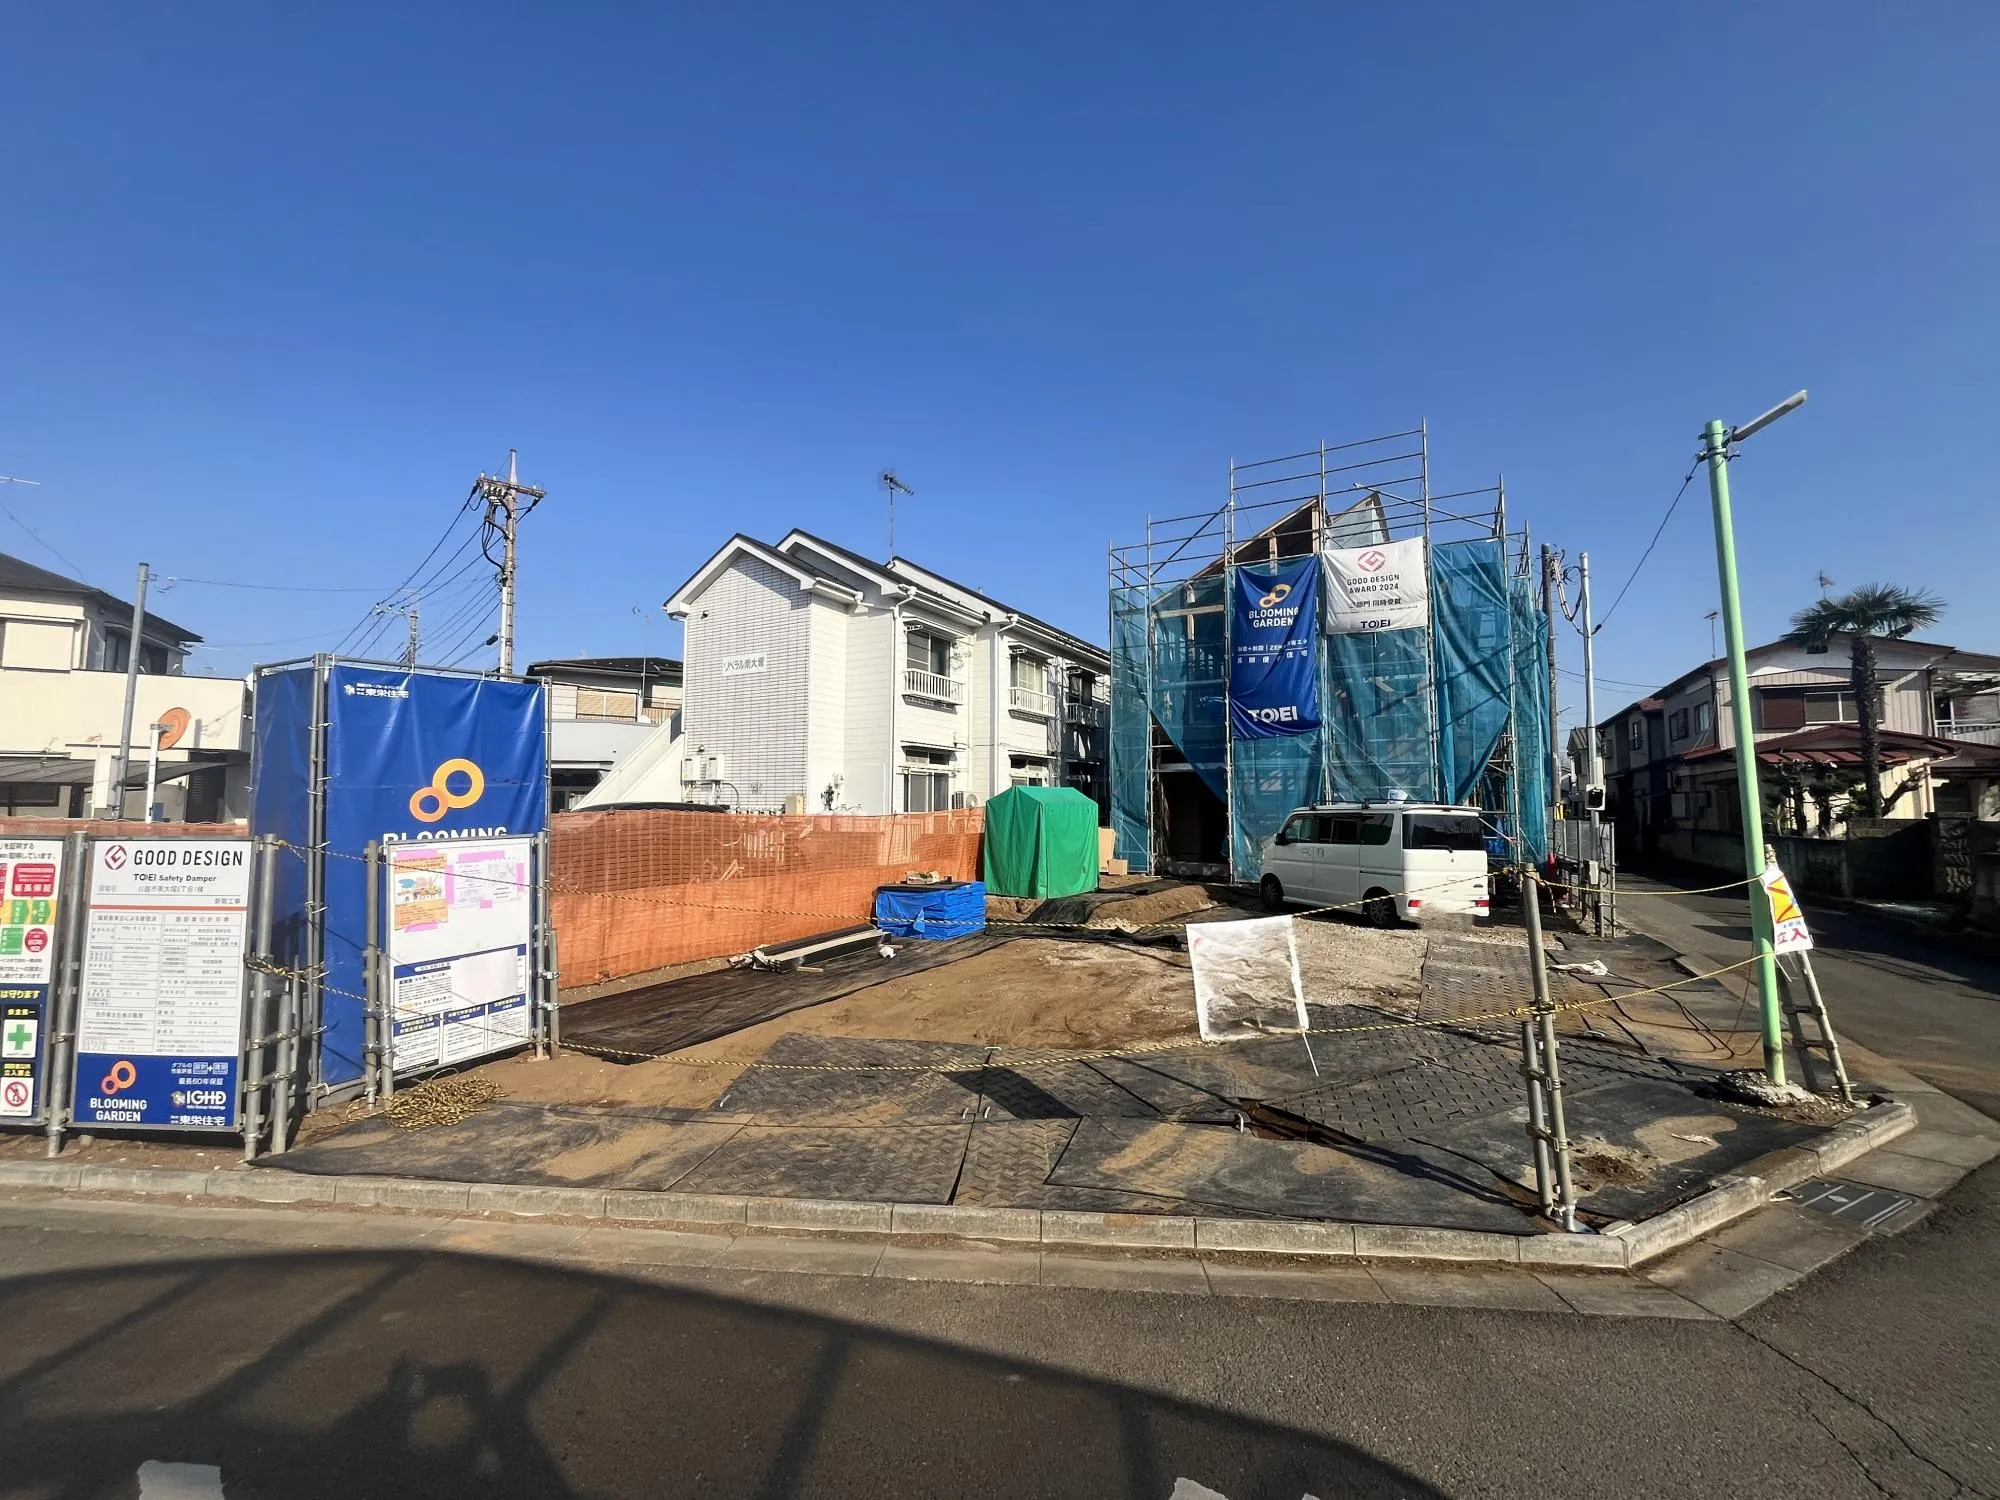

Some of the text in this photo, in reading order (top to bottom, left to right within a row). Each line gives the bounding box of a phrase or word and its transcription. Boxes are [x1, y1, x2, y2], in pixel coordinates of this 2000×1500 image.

[1346, 574, 1400, 586] GOOD DESIGN
[1349, 583, 1399, 594] AWARD 2024
[1248, 606, 1299, 619] BLOOMING
[1253, 617, 1295, 628] GARDEN
[133, 849, 244, 867] GOOD DESIGN
[159, 874, 184, 883] Safety
[185, 874, 217, 883] Damper
[89, 1097, 148, 1111] BLOOMING
[95, 1109, 142, 1122] GARDEN
[179, 1114, 226, 1126] 東栄住宅
